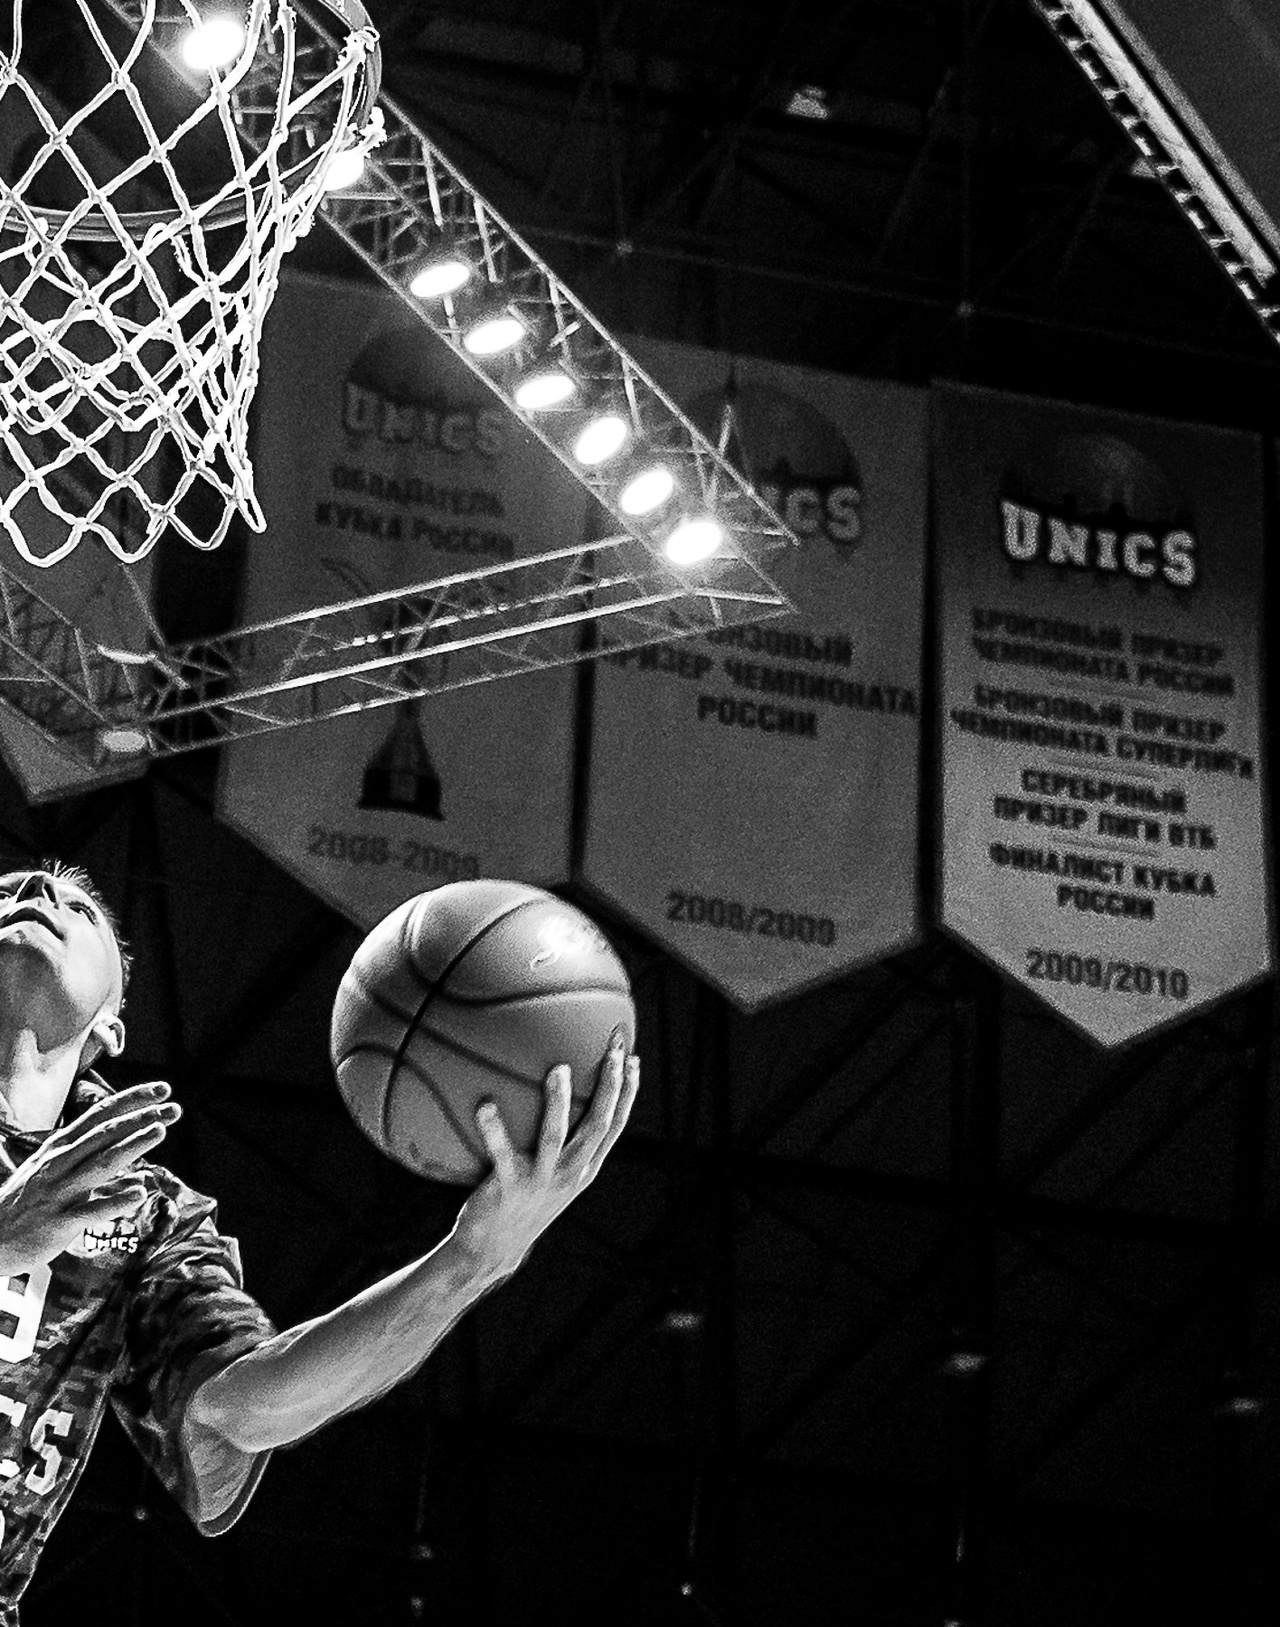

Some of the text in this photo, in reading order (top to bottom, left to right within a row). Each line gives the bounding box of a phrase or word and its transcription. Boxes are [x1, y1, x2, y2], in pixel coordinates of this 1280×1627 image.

[346, 382, 505, 456] UNICS
[1000, 499, 1197, 588] UNICS
[697, 696, 819, 739] РОССИИ
[994, 796, 1088, 831] ПРИЗЕР
[989, 843, 1218, 898] ФИНАЛИСТ КУБКА
[1055, 883, 1157, 923] РОССИИ
[1026, 950, 1191, 1001] 2009/2010
